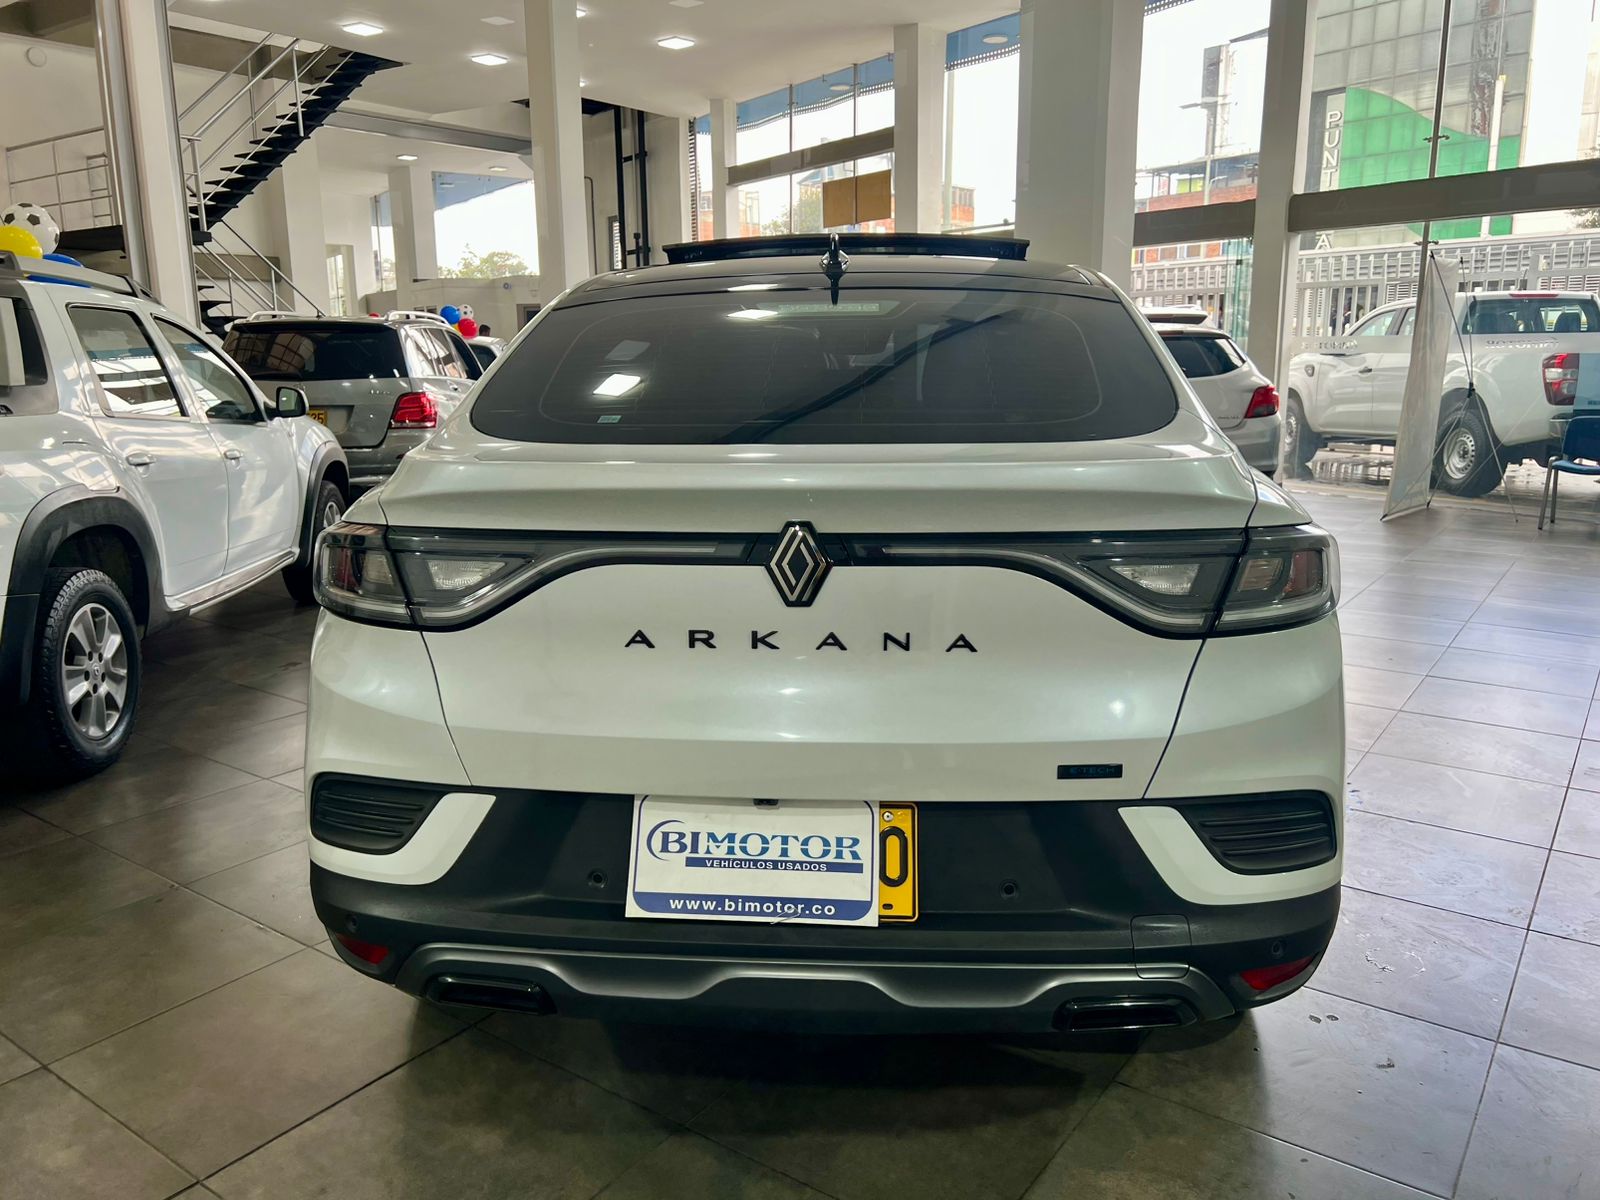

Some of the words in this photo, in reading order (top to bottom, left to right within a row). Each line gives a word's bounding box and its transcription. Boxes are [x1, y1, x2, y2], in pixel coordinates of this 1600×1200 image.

[625, 629, 978, 653] ARKANA
[658, 831, 863, 861] BIMOTOR
[705, 858, 774, 869] VEHÍCULOS
[777, 862, 828, 872] USADOS
[669, 898, 836, 916] www.bimotor.co
